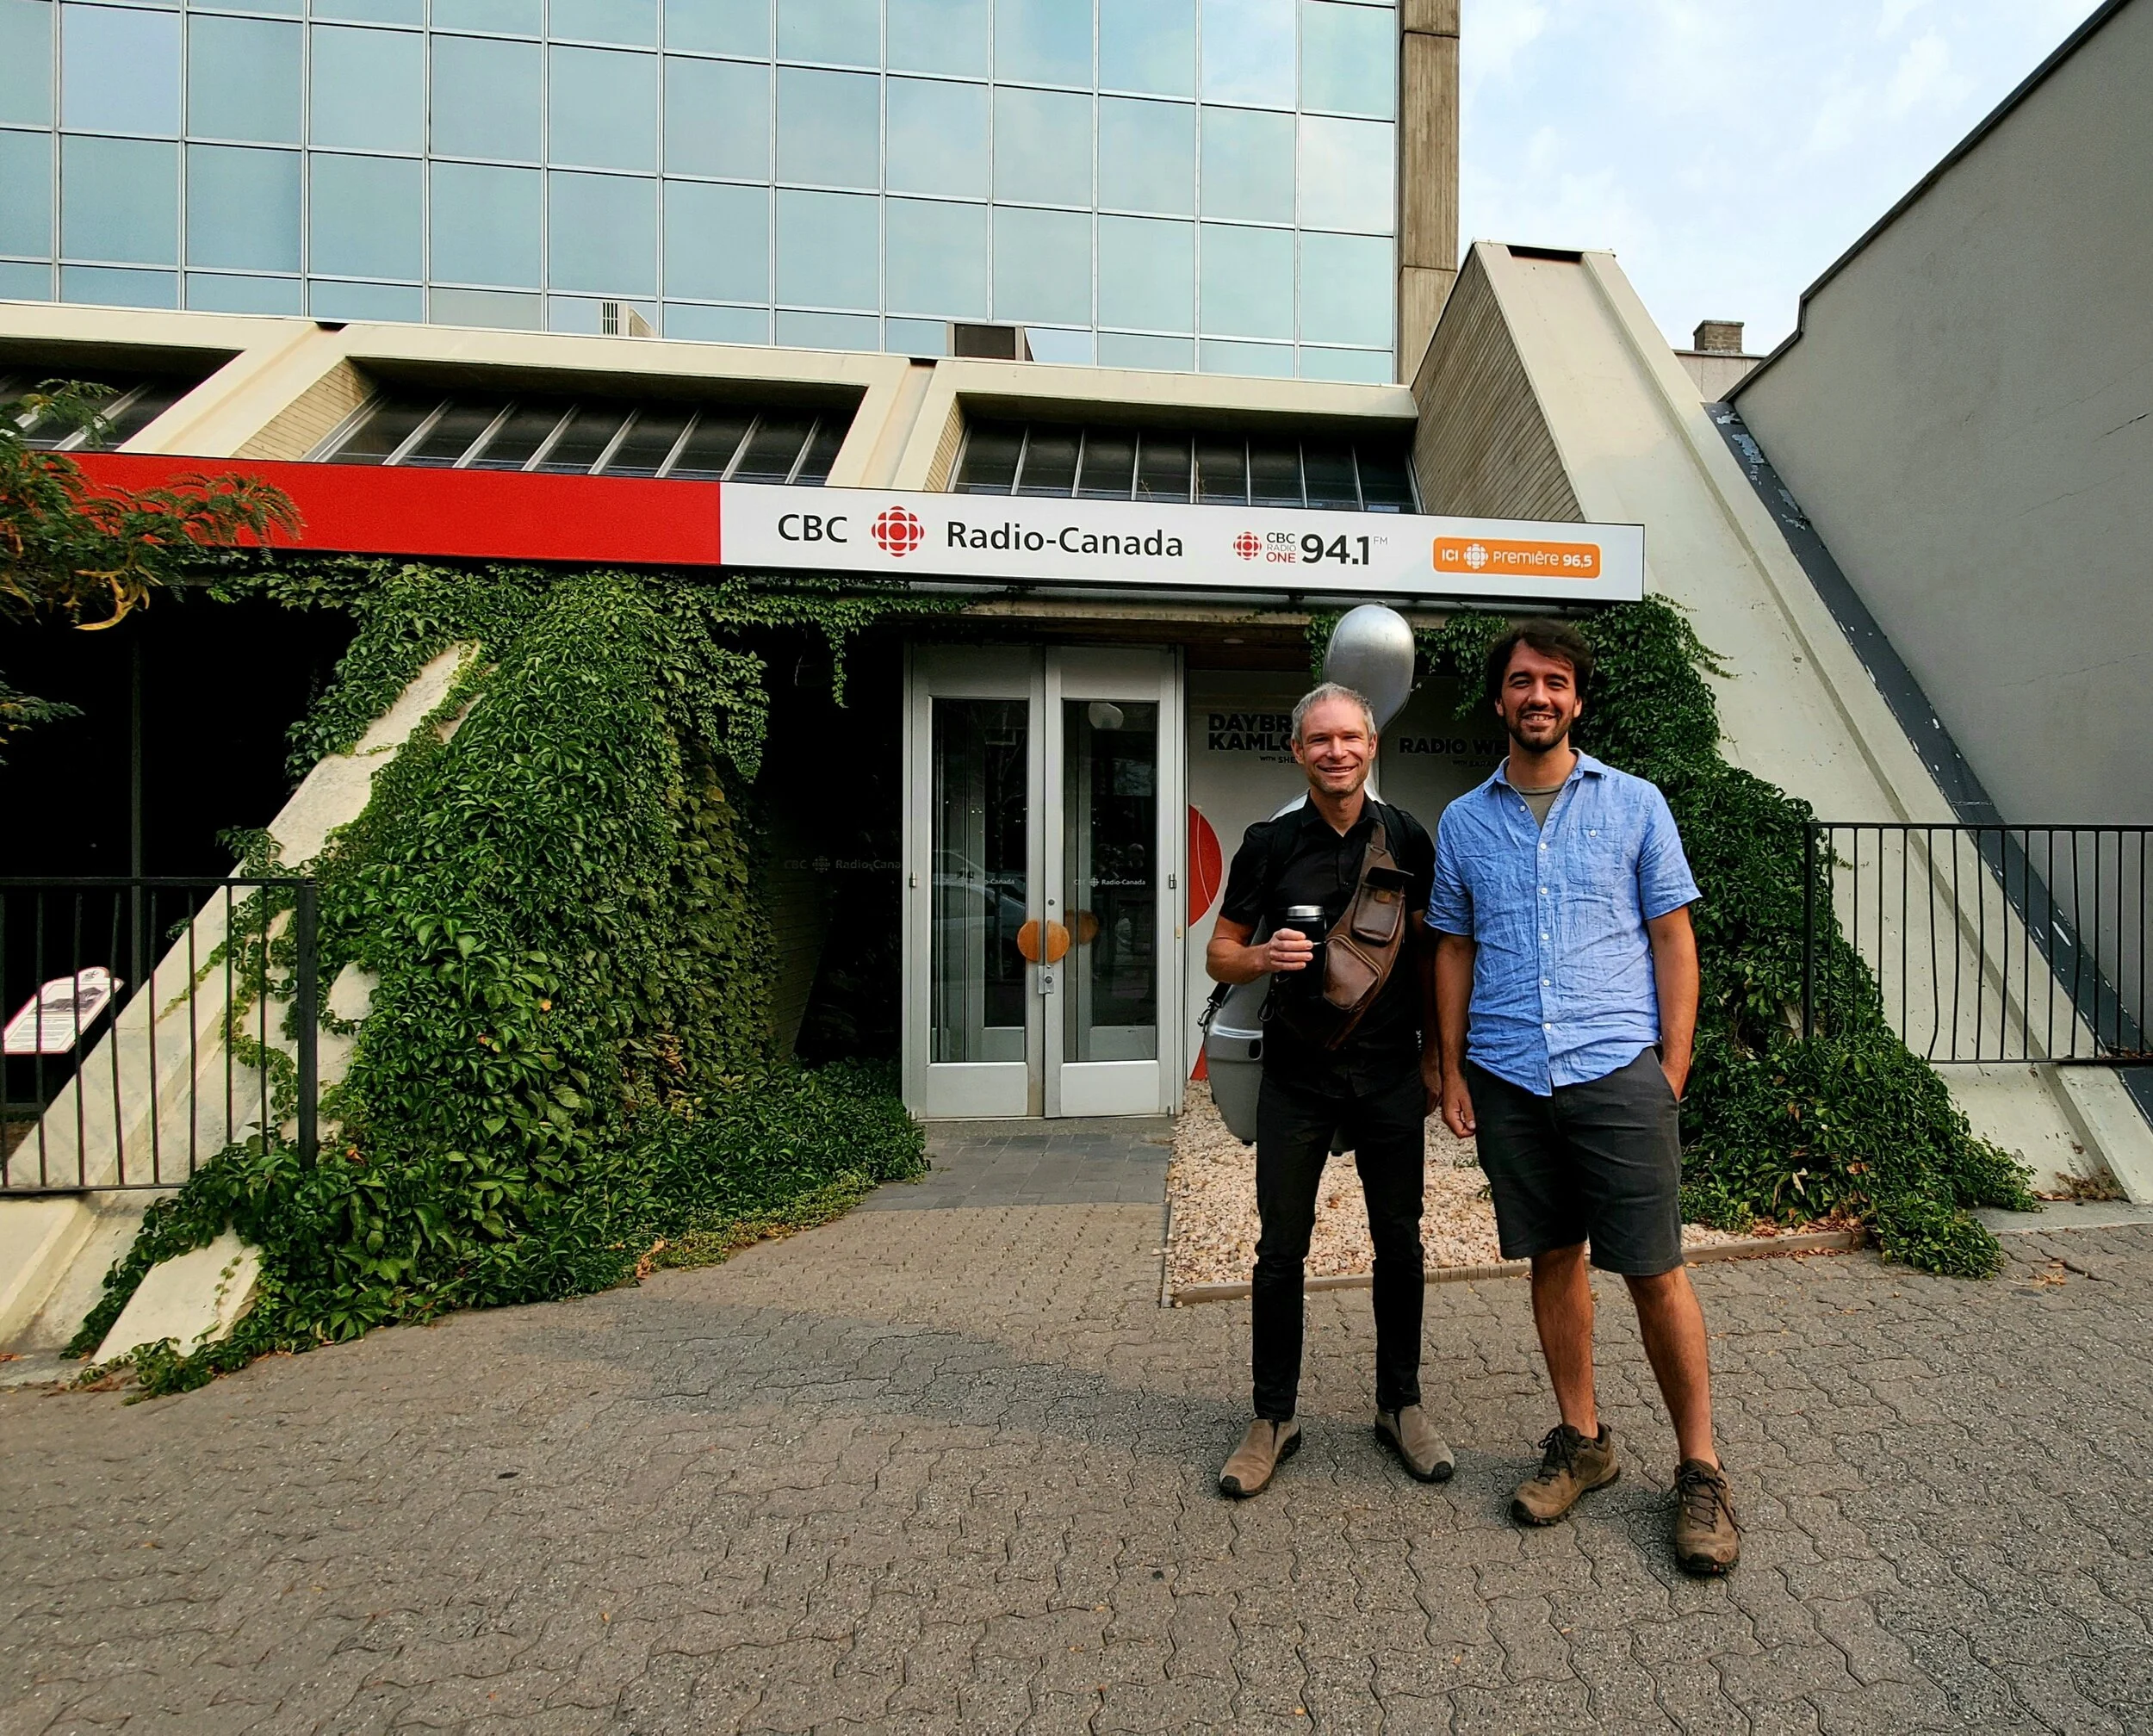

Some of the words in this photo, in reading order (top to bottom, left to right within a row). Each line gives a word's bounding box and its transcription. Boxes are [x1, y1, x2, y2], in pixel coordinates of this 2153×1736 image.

[777, 514, 848, 543] CBC
[946, 520, 1183, 557] Radio-Canada
[1266, 531, 1296, 544] CBC
[1373, 536, 1389, 545] FM
[1267, 543, 1297, 552] RADIO
[1300, 533, 1370, 566] 94.1
[1266, 551, 1297, 564] ONE
[1441, 549, 1459, 562] ICI
[1562, 554, 1593, 568] 96,5
[1209, 714, 1293, 732] DAYBR
[1209, 733, 1293, 751] KAMLO
[1399, 738, 1467, 754] RADIO
[1473, 739, 1509, 755] WE
[835, 859, 902, 870] Radio-Cana
